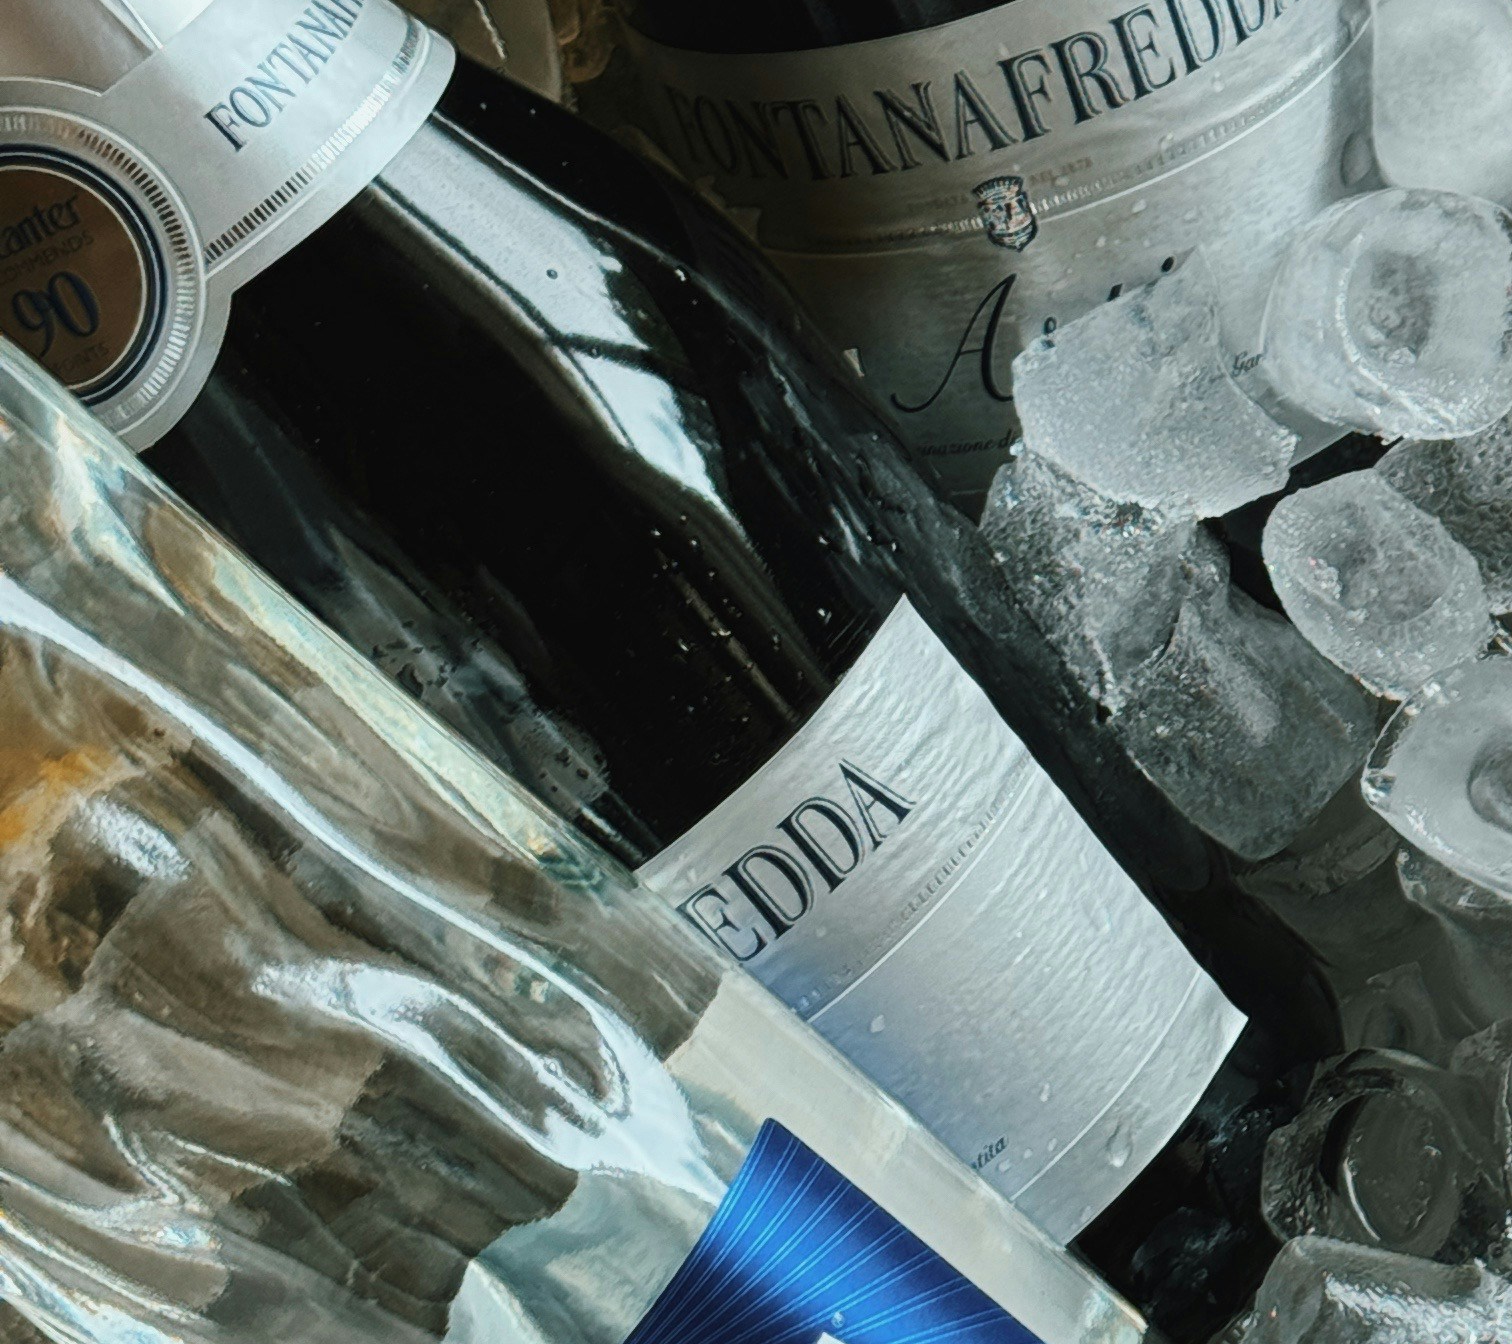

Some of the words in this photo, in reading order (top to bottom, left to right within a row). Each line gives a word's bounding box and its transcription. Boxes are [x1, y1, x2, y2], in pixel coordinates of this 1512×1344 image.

[0, 194, 80, 258] anter
[12, 271, 98, 357] 90
[677, 757, 917, 962] EDDA
